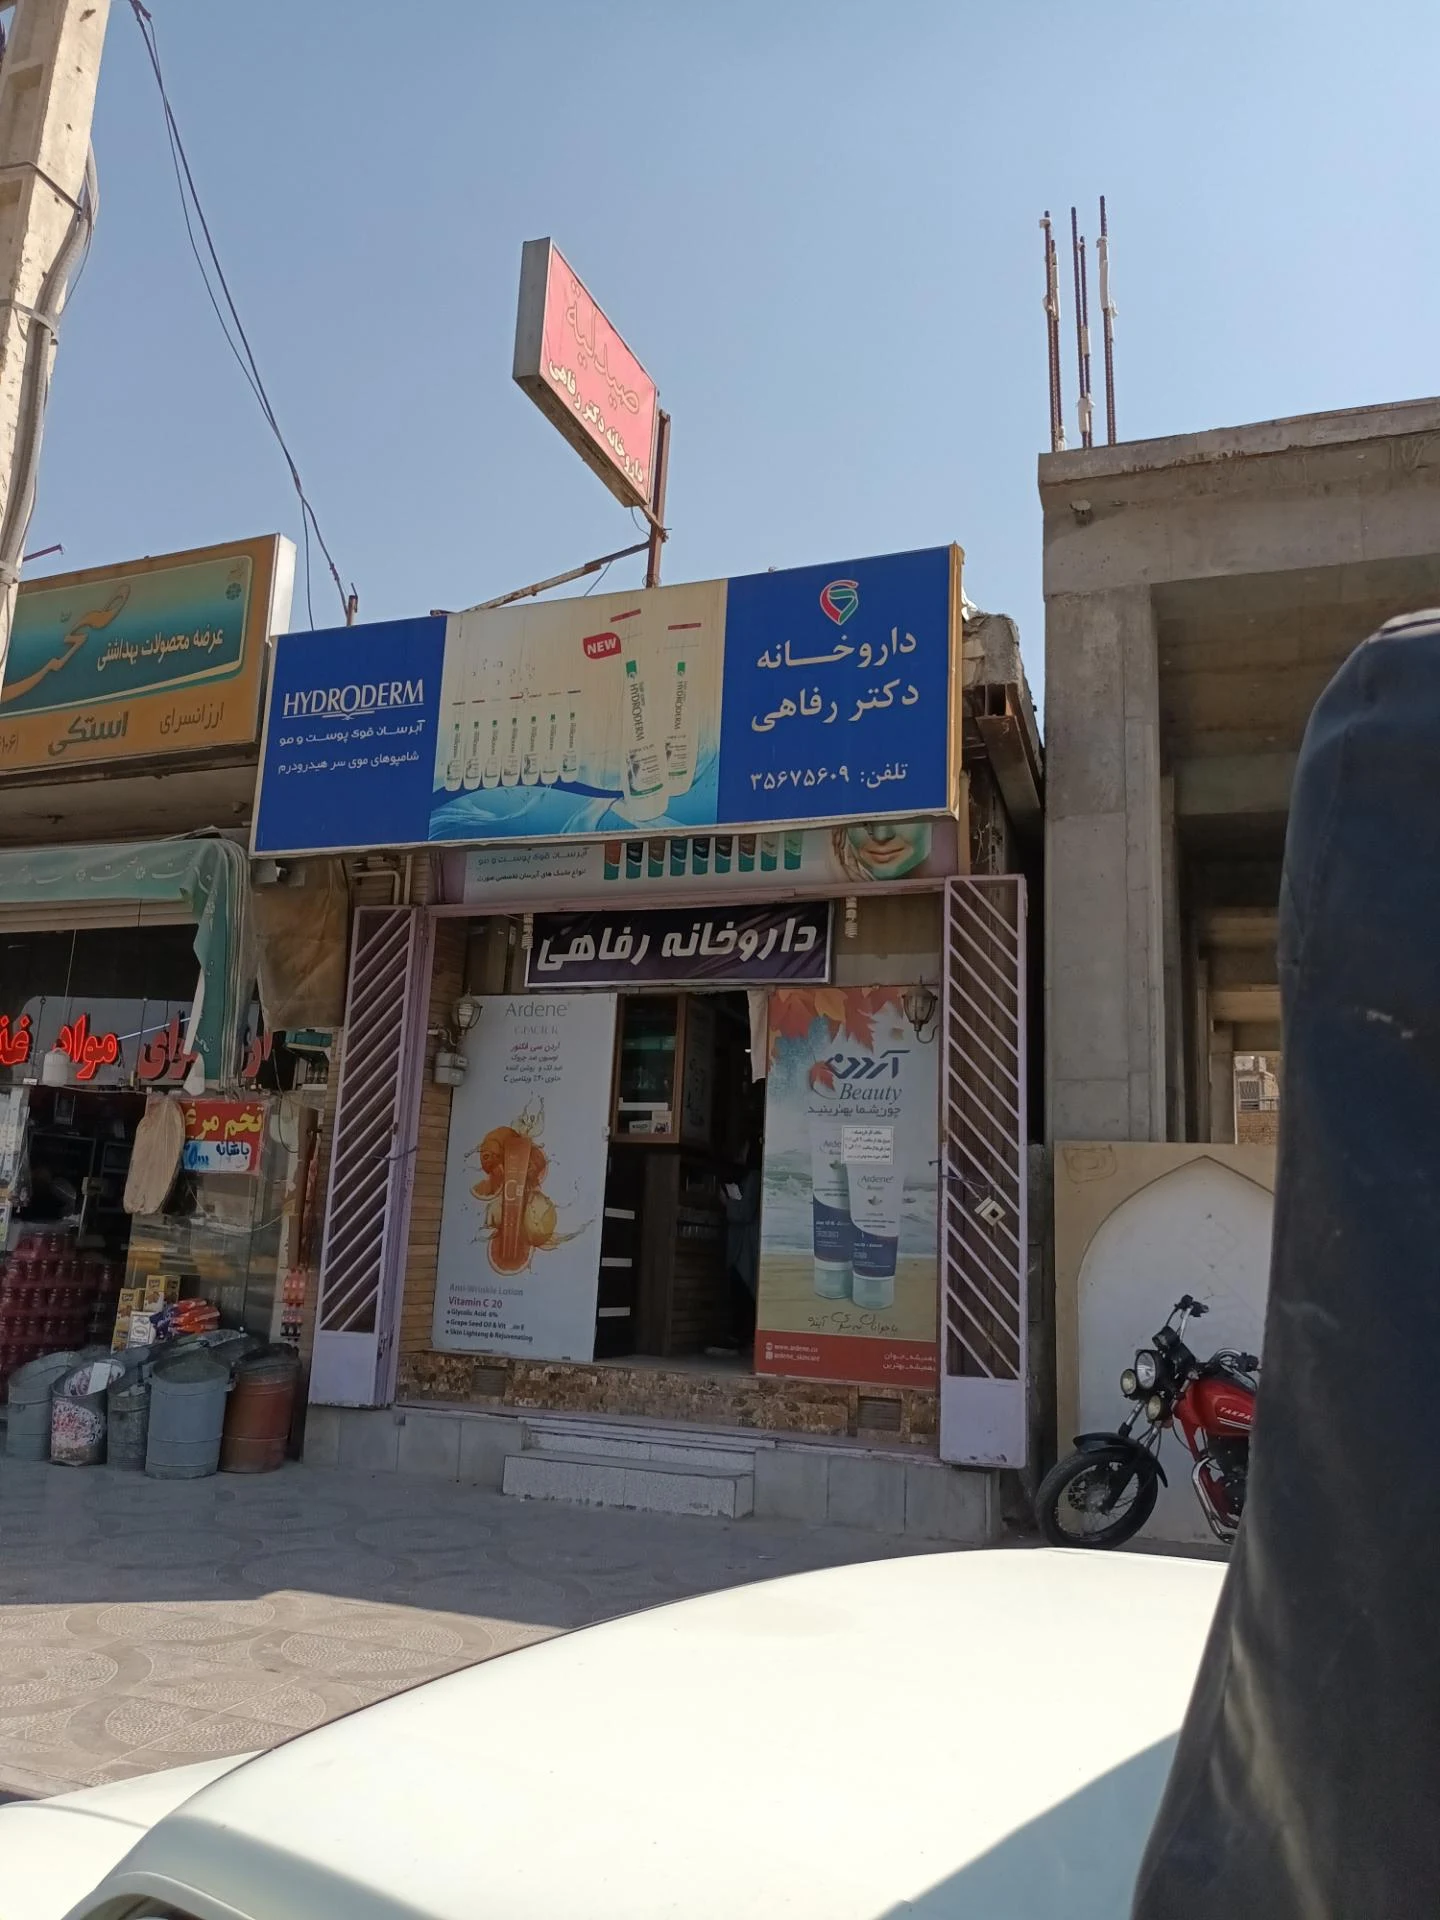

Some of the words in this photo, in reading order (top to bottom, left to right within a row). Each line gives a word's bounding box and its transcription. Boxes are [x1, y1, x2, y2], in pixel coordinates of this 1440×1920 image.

[583, 401, 605, 434] دکتر
[606, 427, 643, 482] داروخانه
[142, 631, 190, 663] محصولات
[194, 625, 224, 655] عرضه
[587, 638, 618, 655] NEW
[757, 626, 917, 668] داروخانه
[97, 640, 138, 672] بهداشتی
[283, 678, 425, 717] HYDRODERM
[751, 686, 839, 732] رفاهی
[849, 679, 919, 722] دکتر
[305, 731, 349, 744] پوست
[350, 726, 374, 739] قوی
[376, 719, 426, 736] آبرسان
[279, 736, 295, 747] مو
[296, 735, 304, 745] و
[277, 761, 328, 775] هیدرودرم
[329, 760, 346, 771] سر
[347, 757, 369, 770] موی
[370, 751, 420, 767] شامپوهای
[750, 765, 850, 791] ۳۵۶۷۵۶۰۹
[536, 925, 651, 972] رفاهی
[661, 917, 817, 964] داروخانه
[505, 1001, 568, 1017] Ardene
[839, 1082, 903, 1105] Beauty
[224, 1104, 264, 1140] تخم
[448, 1296, 482, 1308] Vitamin
[482, 1299, 490, 1308] C
[490, 1299, 503, 1309] 20
